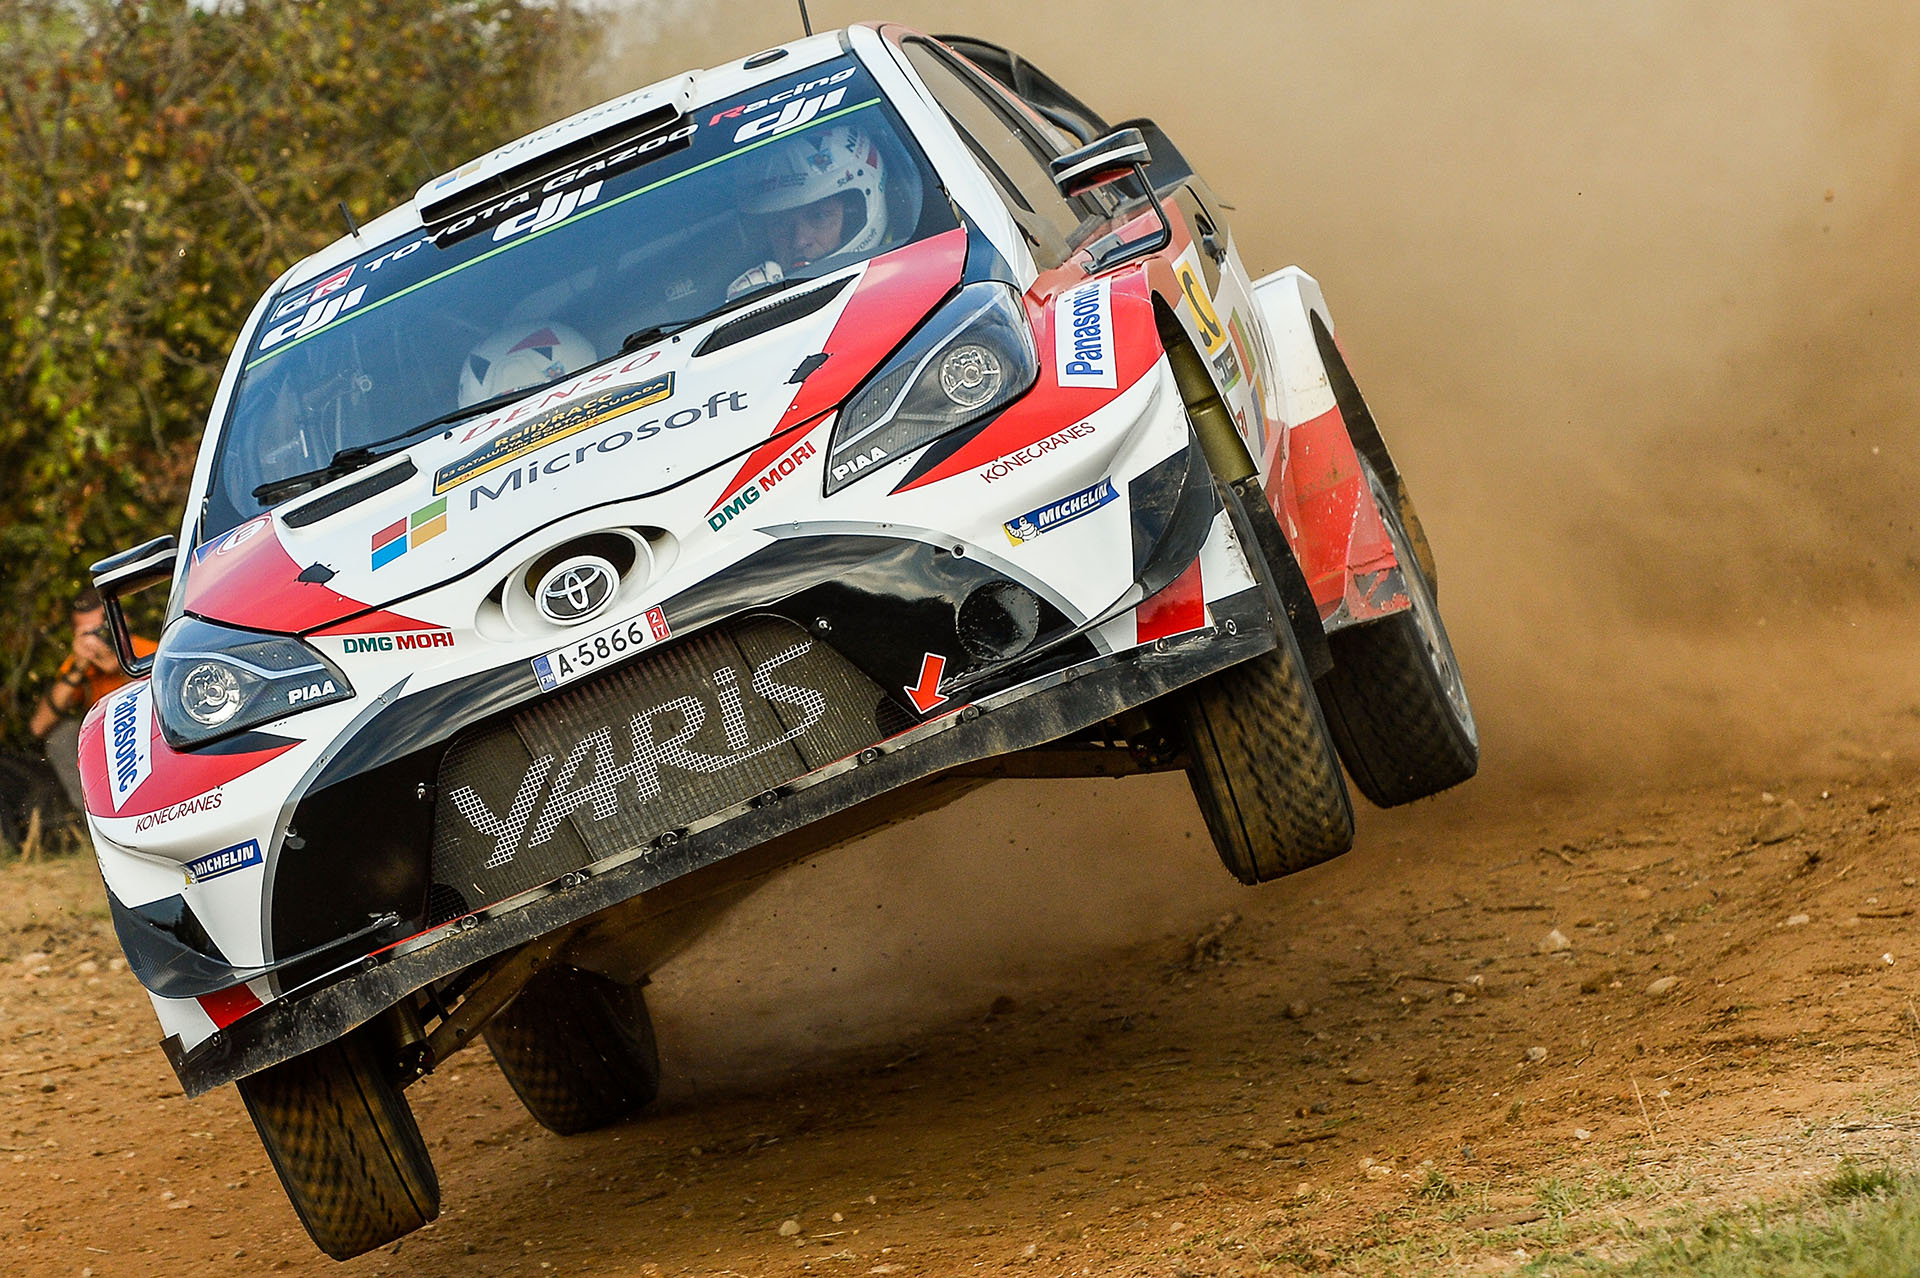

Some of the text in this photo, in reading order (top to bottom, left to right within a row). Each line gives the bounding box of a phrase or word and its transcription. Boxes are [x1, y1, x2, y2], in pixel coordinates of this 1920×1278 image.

[494, 91, 654, 160] Microsoft
[734, 87, 847, 143] dji
[364, 191, 530, 272] TOYOTA
[542, 124, 698, 194] GAZOO
[709, 67, 856, 127] Racing
[492, 180, 603, 241] dji
[258, 284, 367, 351] dji
[1065, 282, 1104, 375] Panasonic
[460, 351, 660, 443] DENSO
[494, 393, 612, 448] RallyRACC
[441, 469, 456, 479] 53
[587, 382, 665, 415] DAURADA
[469, 390, 747, 510] Microsoft
[707, 441, 817, 532] DMG MORI
[832, 446, 889, 482] PIAA
[1038, 482, 1109, 527] MICHELIN
[343, 631, 455, 654] DMG MORI
[649, 611, 659, 624] 2
[652, 624, 666, 639] 17
[288, 680, 336, 705] PIAA
[541, 674, 554, 685] FIN
[113, 682, 149, 793] Panasonic
[135, 793, 222, 834] KONECRANES
[192, 845, 254, 876] MICHELIN
